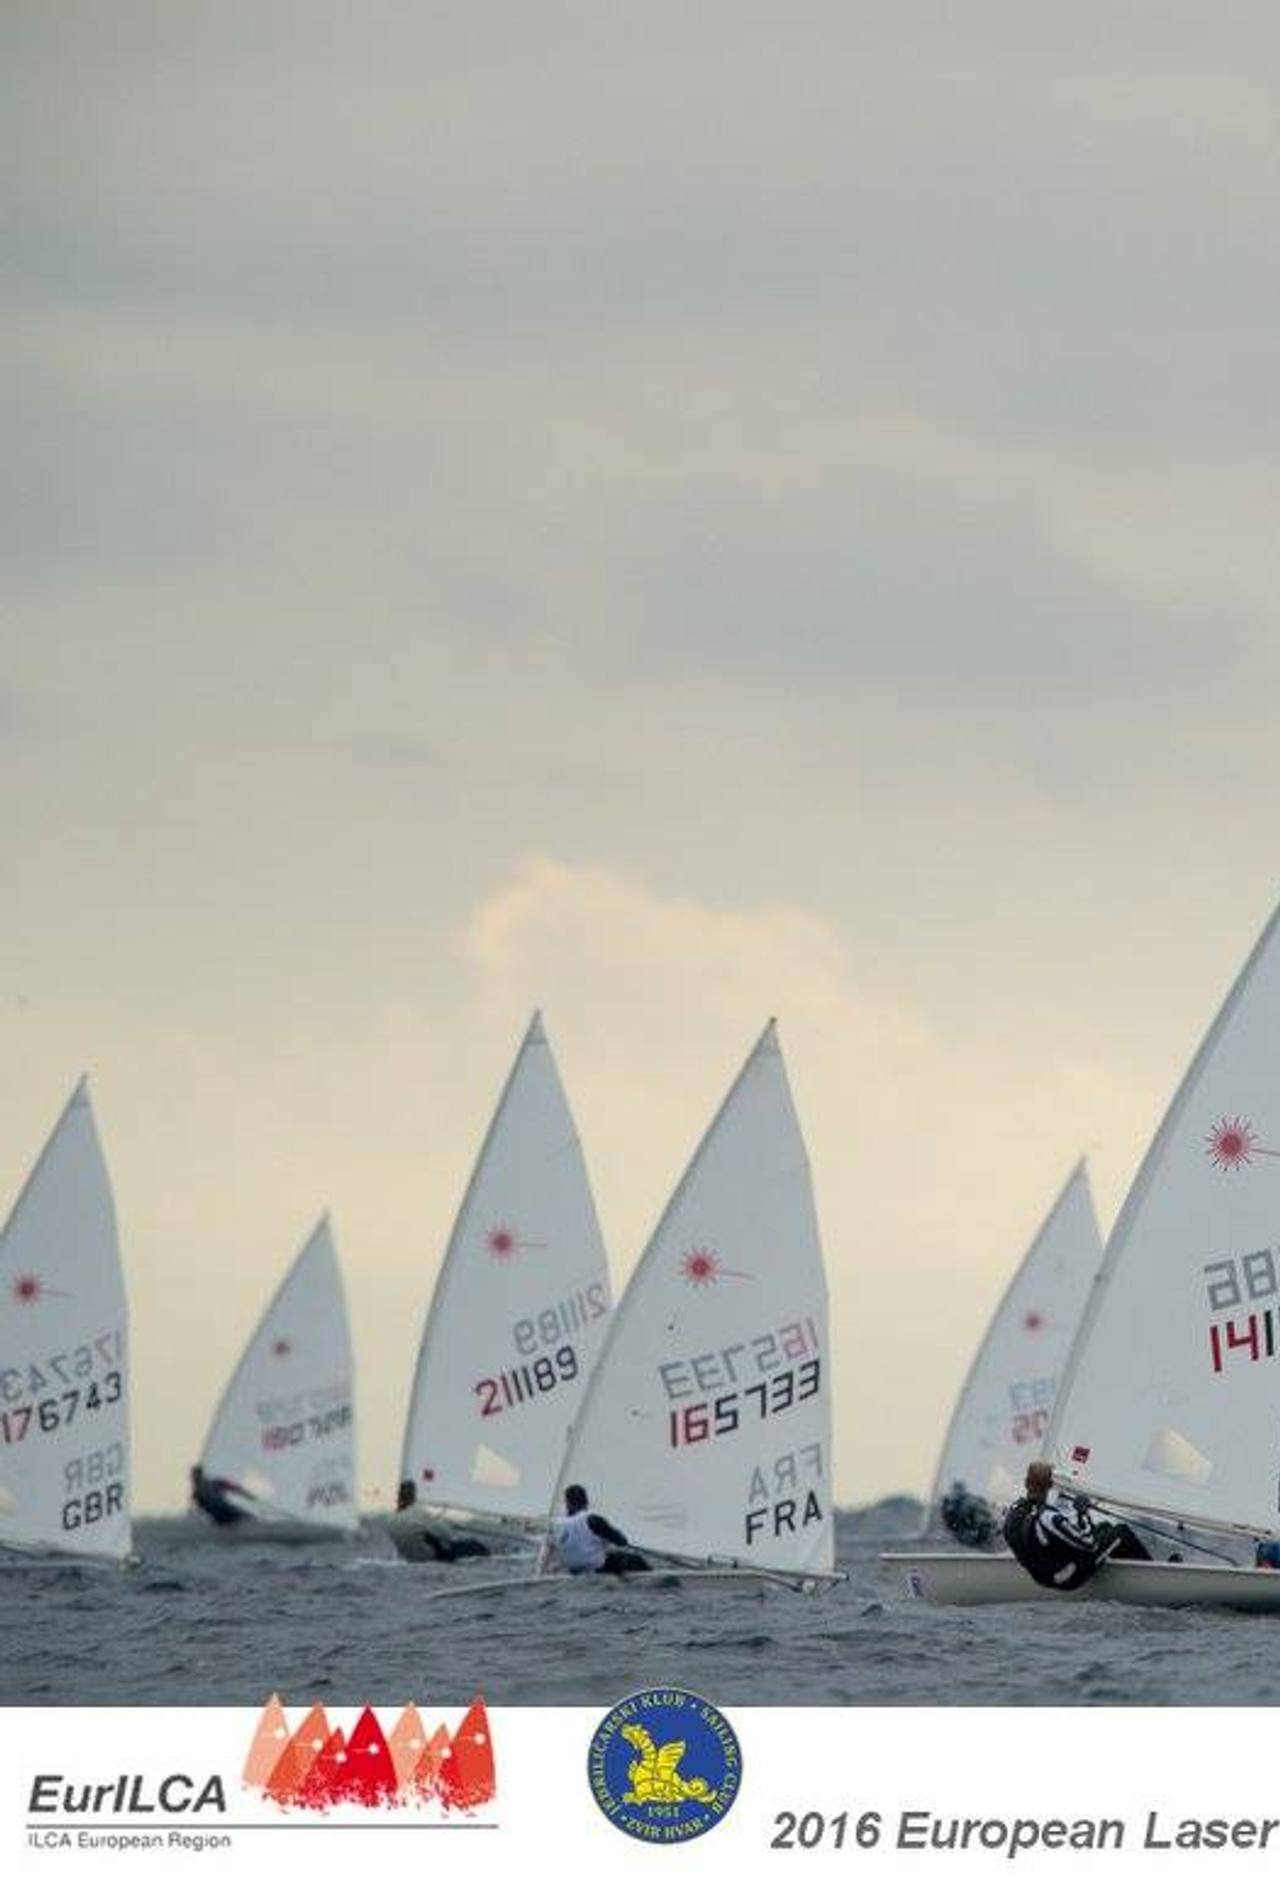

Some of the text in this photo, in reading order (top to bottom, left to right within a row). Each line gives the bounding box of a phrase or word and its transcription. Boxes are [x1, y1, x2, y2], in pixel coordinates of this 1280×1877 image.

[1, 1370, 121, 1444] 176743
[474, 1345, 579, 1418] 211189
[669, 1359, 821, 1449] 165733
[62, 1482, 123, 1531] GBR
[745, 1491, 823, 1545] FRA
